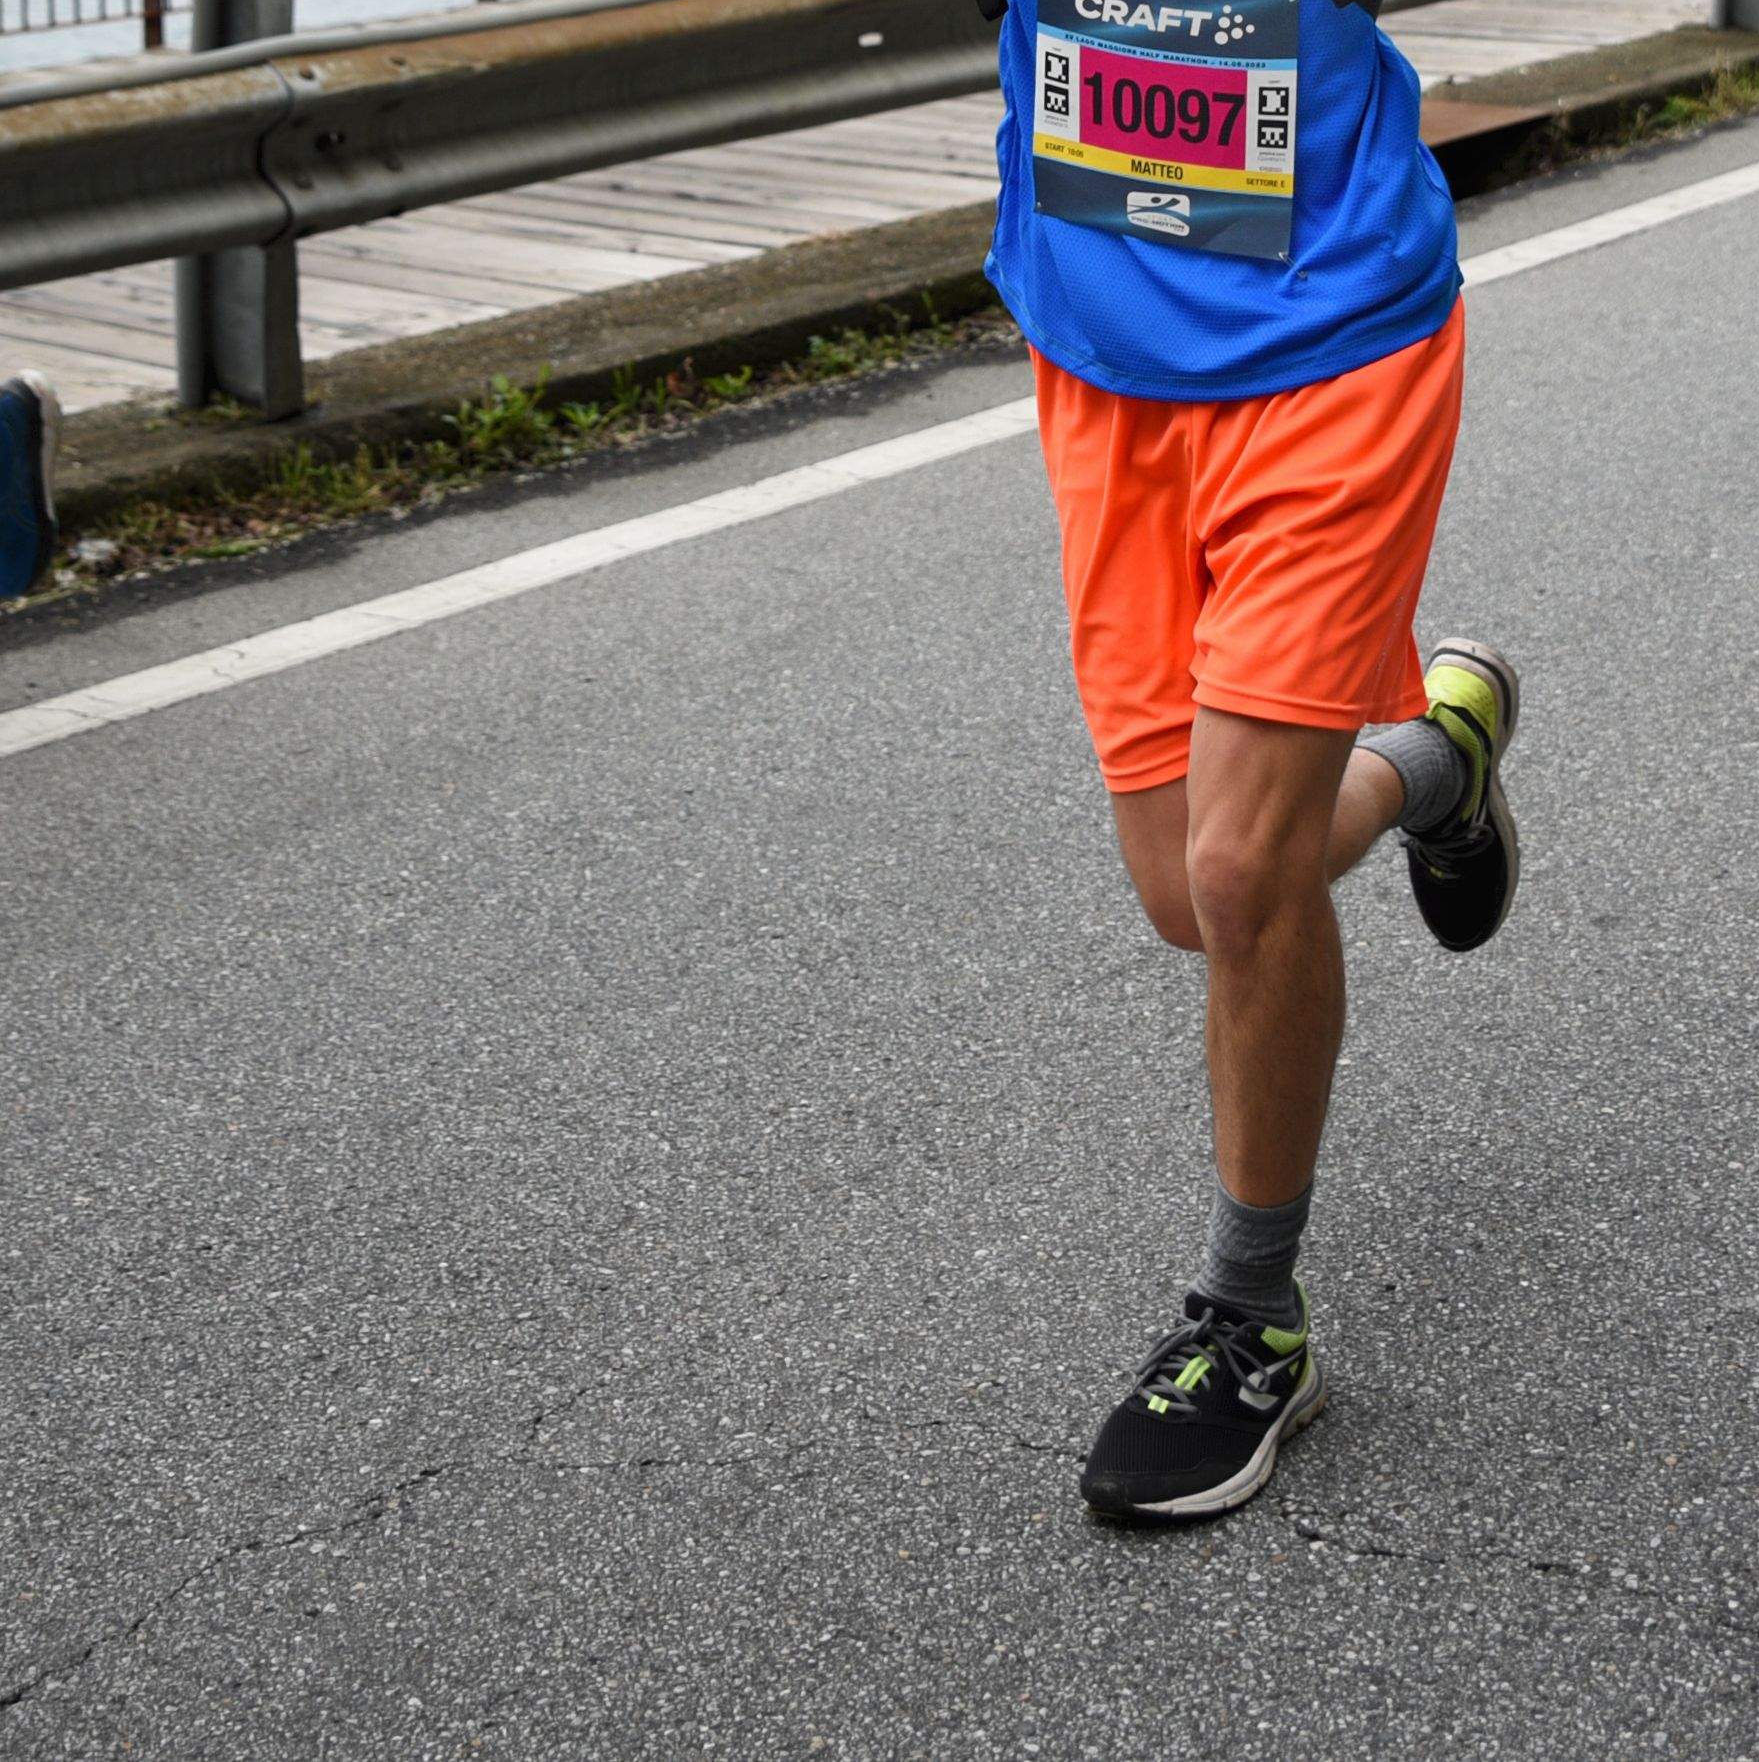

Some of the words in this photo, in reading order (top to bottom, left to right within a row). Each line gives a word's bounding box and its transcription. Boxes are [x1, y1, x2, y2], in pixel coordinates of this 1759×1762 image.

[1076, 36, 1095, 46] LAGO
[1097, 42, 1137, 55] MAGGIORE
[1140, 50, 1160, 58] HALF
[1163, 54, 1208, 65] MARATHON
[1084, 71, 1246, 147] 10097
[1045, 142, 1065, 153] START
[1131, 159, 1184, 181] MATTEO
[1246, 177, 1278, 187] SETTORE
